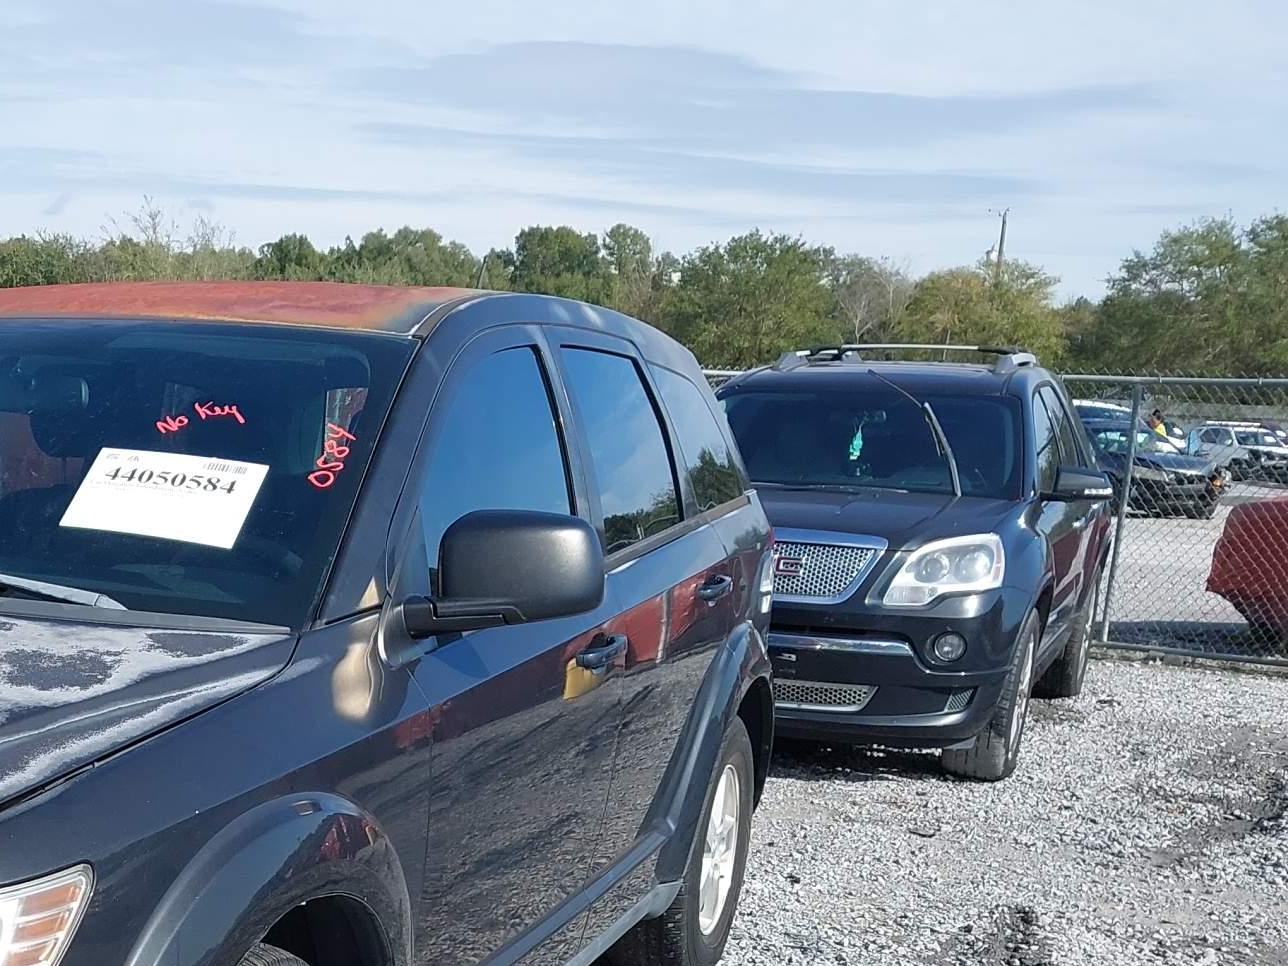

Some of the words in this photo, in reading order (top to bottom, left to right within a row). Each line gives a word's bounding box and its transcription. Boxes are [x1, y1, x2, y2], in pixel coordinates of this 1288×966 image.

[156, 416, 188, 433] No
[194, 400, 245, 424] Key
[307, 422, 356, 488] 0584
[105, 456, 237, 494] 44050584
